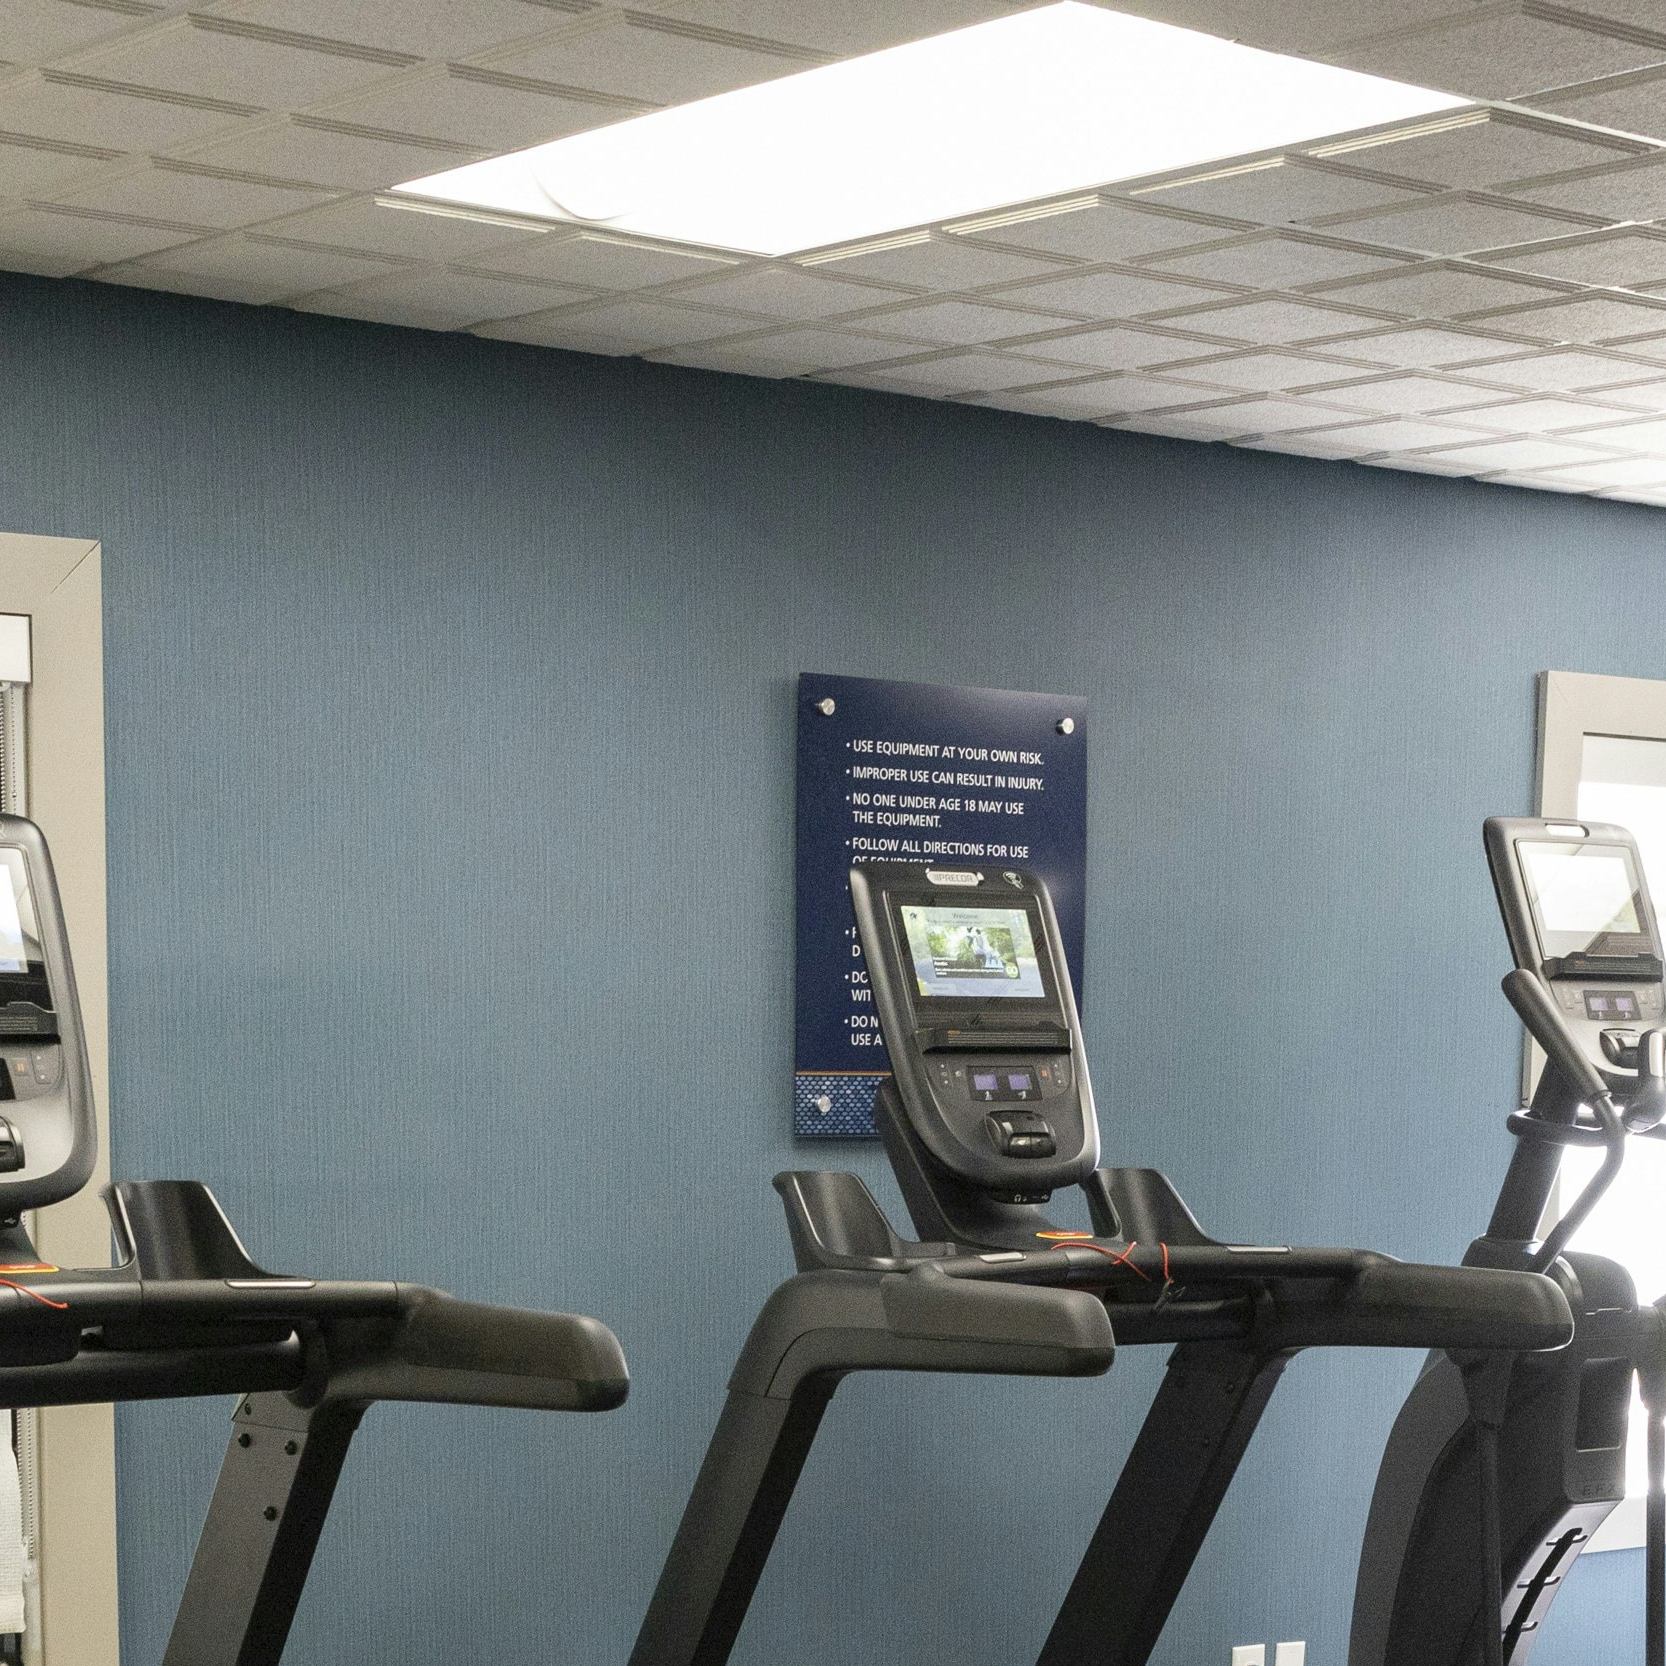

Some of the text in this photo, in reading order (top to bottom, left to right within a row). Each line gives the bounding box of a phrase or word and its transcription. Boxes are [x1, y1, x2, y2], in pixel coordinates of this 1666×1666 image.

[853, 740, 1044, 765] USE EQUIPMENT AT YOUR OWN RISK.
[853, 766, 1044, 790] IMPROPER USE CAN RESULT IN INJURY.
[853, 793, 1024, 814] NO ONE UNDER AGE 18 MAY USE
[853, 811, 941, 828] THE EQUIPMENT.
[853, 837, 1029, 858] FOLLOW ALL DIRECTIONS FOR USE
[936, 873, 974, 882] PRECOR
[851, 1016, 868, 1027] DO
[851, 1034, 871, 1046] USE
